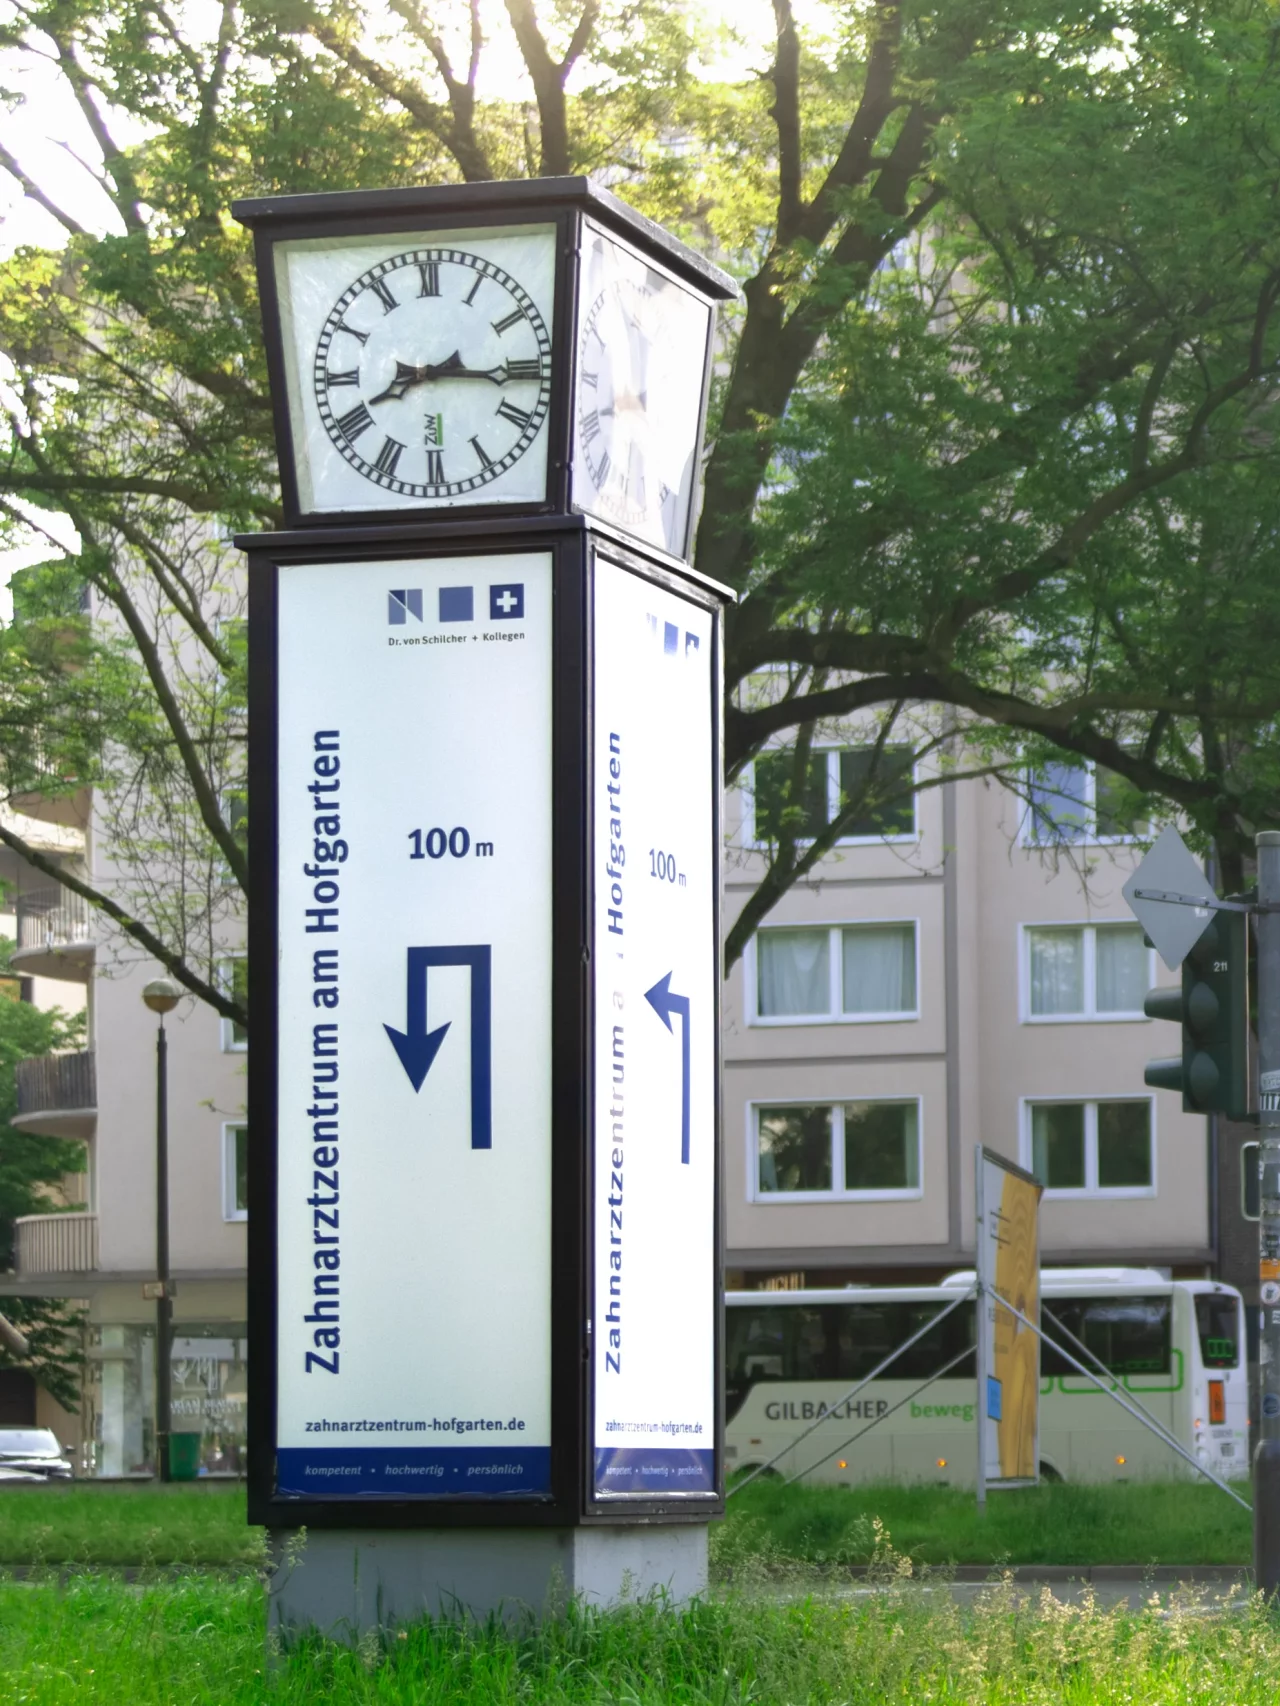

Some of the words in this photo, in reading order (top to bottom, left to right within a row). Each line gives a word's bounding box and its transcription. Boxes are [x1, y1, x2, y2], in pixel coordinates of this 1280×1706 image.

[388, 636, 402, 647] Dr.
[403, 637, 421, 646] von
[422, 634, 468, 645] Schilcher
[483, 631, 526, 643] Kollegen
[304, 729, 349, 934] Hofgarten
[407, 826, 470, 860] 100
[475, 839, 494, 858] m
[605, 731, 626, 936] Hofgarten
[648, 847, 676, 883] 100
[677, 871, 687, 888] m
[313, 949, 341, 1009] am
[304, 1023, 341, 1375] Zahnarztzentrum
[605, 1024, 625, 1376] Zahnarztzentrum
[305, 1417, 526, 1435] zahnarztzentrum-hofgarten.de
[764, 1400, 889, 1421] GILBACHER
[909, 1401, 977, 1423] beweg
[304, 1464, 362, 1478] kompetent
[384, 1464, 445, 1478] hochwertig
[467, 1463, 524, 1477] persönlich
